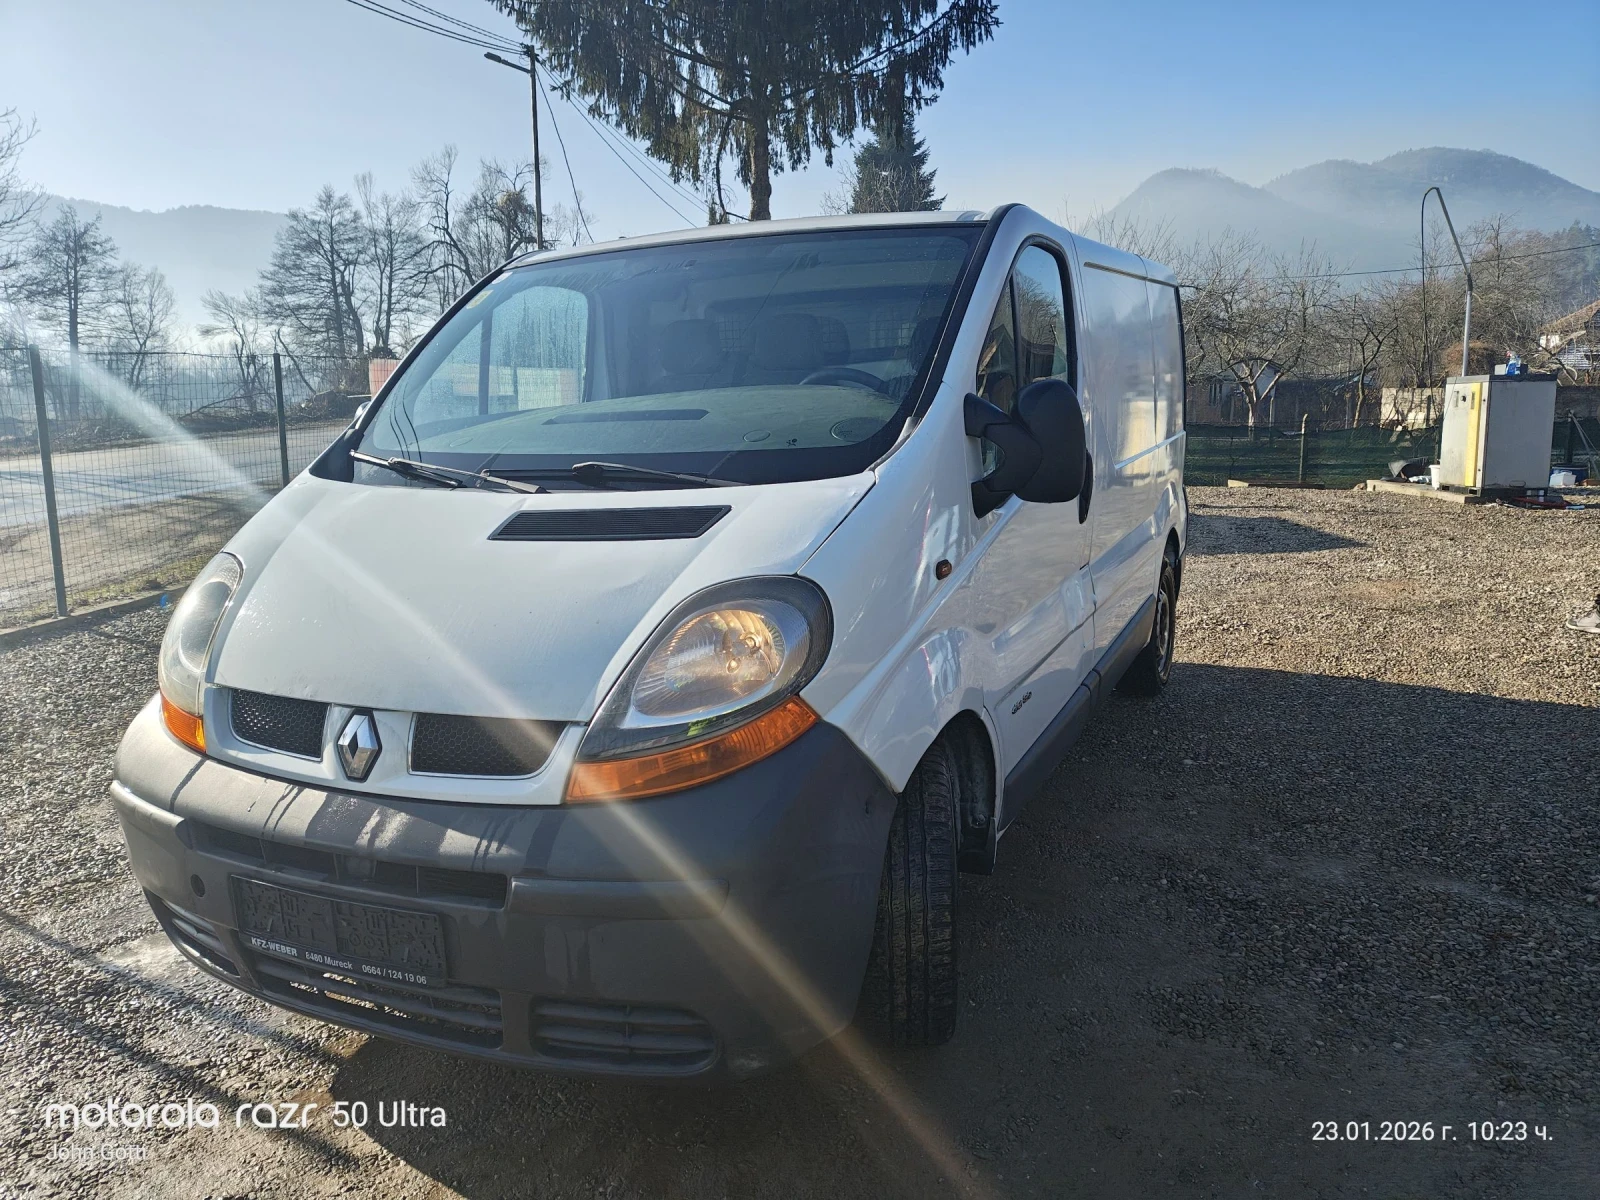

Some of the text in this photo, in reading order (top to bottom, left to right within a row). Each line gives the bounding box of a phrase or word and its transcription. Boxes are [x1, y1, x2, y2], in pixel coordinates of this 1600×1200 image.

[251, 937, 297, 957] KFZ-WEBER
[324, 954, 353, 970] Mureck
[362, 964, 382, 976] 0664
[387, 969, 403, 980] 124
[404, 972, 415, 982] 19
[416, 974, 427, 985] 06
